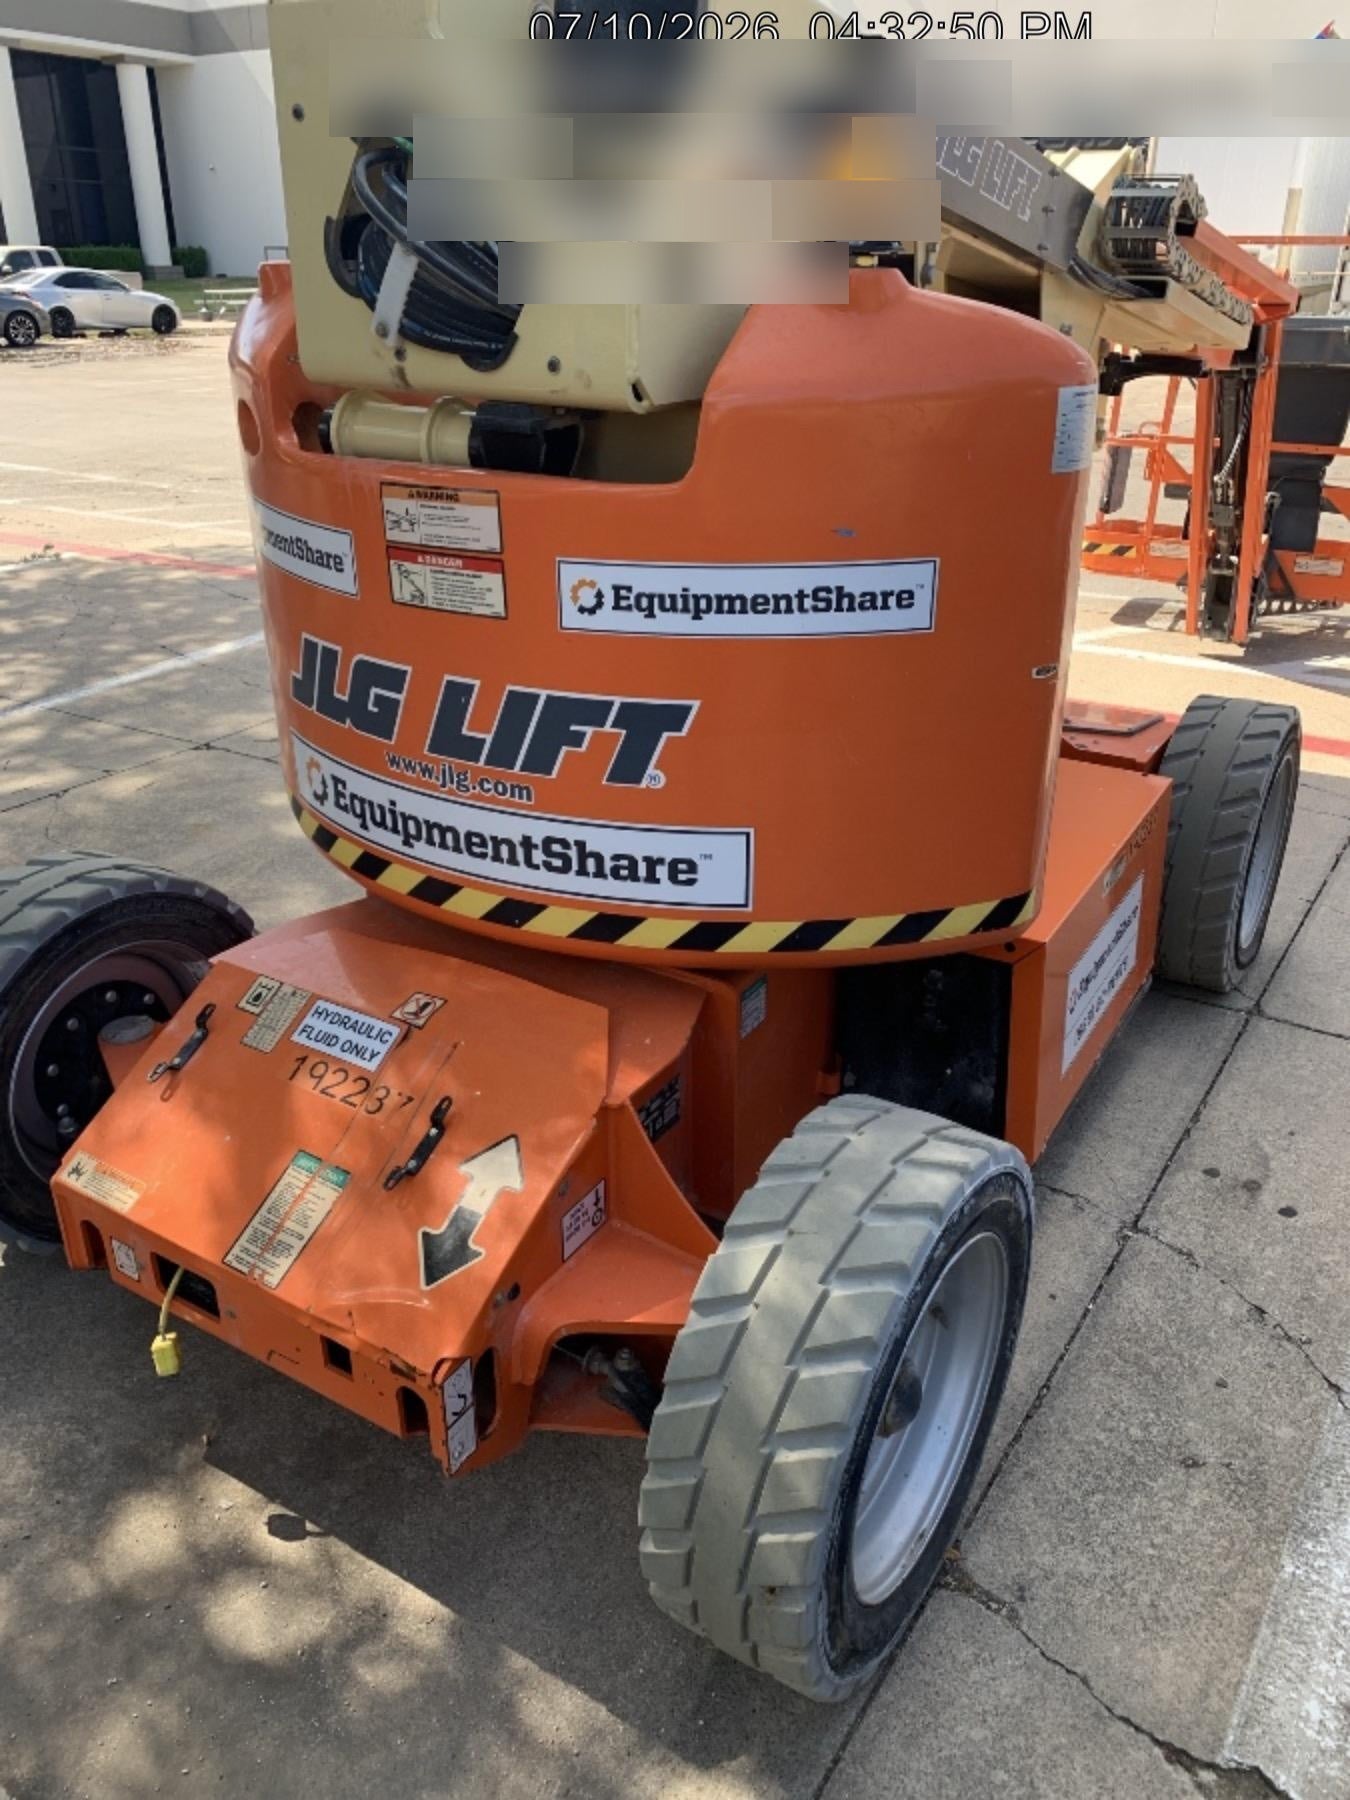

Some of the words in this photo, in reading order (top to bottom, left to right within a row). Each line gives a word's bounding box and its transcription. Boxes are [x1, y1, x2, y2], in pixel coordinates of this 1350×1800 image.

[290, 632, 412, 743] JLG
[385, 750, 534, 803] www.jlg.com
[297, 1023, 340, 1048] FLUID
[340, 1039, 381, 1063] ONLY
[311, 1005, 393, 1045] HYDRAULIC
